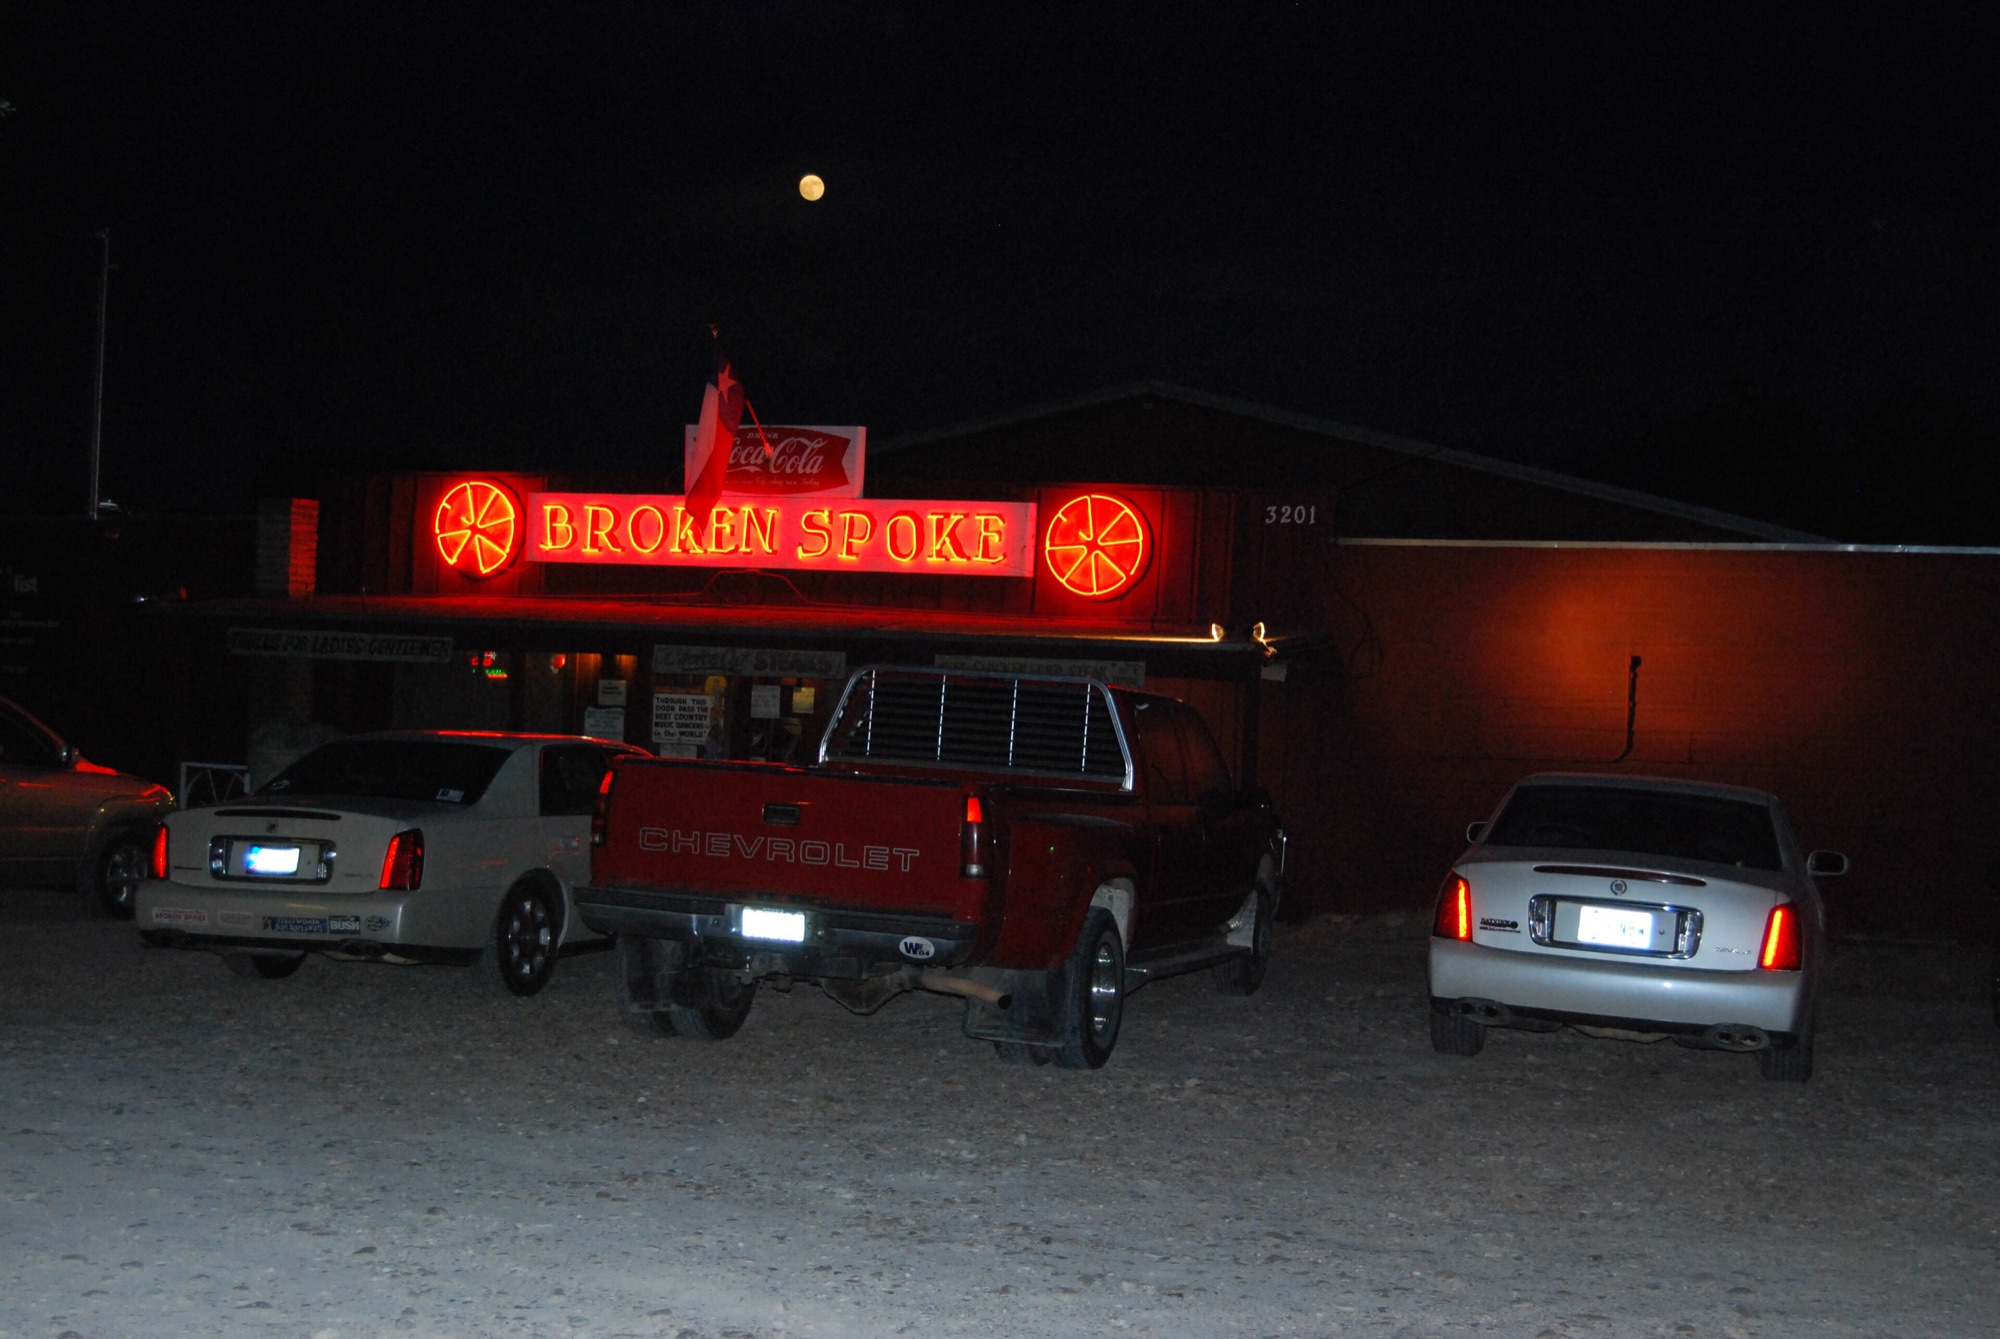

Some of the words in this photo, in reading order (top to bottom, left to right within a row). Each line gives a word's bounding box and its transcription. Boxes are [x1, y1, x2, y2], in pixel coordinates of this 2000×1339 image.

[747, 432, 779, 440] DRNK
[1265, 505, 1316, 525] 3201
[539, 504, 779, 554] BROKEN
[798, 509, 1007, 562] SPOKE
[639, 827, 920, 872] CHEVROLET
[155, 912, 182, 920] BROKEN
[331, 920, 360, 930] BUSH
[904, 942, 917, 955] W
